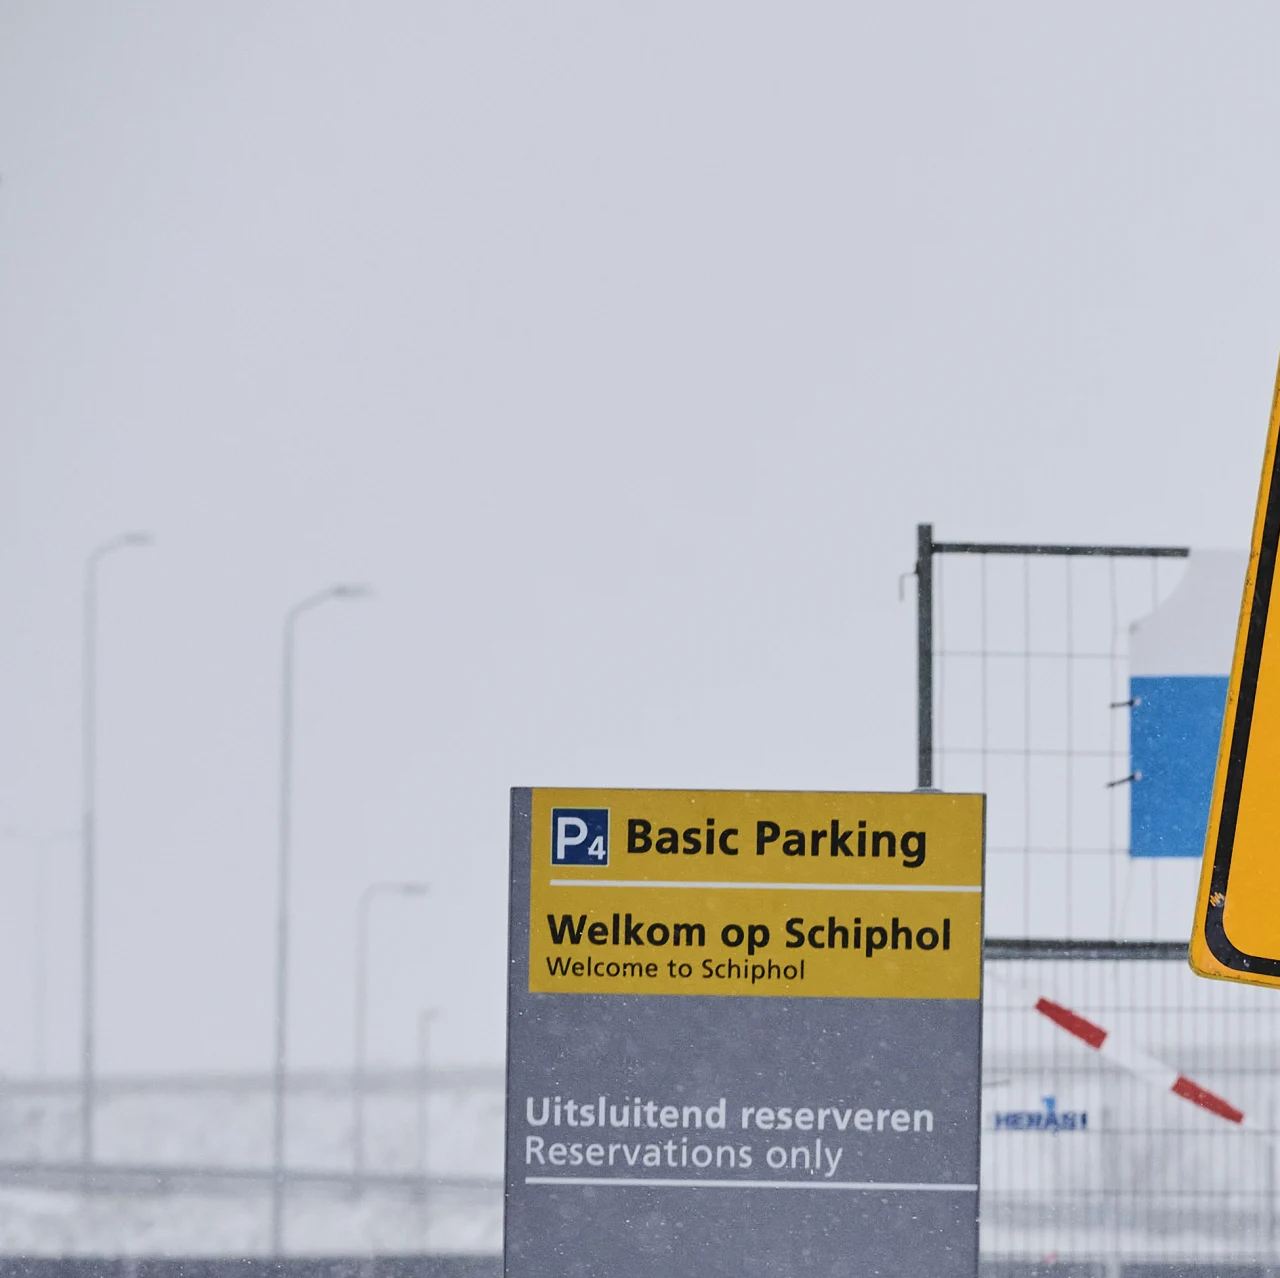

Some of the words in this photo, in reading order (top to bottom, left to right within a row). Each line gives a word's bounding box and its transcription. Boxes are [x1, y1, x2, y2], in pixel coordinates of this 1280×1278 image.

[627, 818, 739, 855] Basic
[756, 820, 927, 868] Parking
[547, 913, 706, 946] Welkom
[720, 924, 770, 955] op
[785, 917, 951, 957] Schiphol
[547, 957, 658, 978] Welcome
[667, 960, 693, 978] to
[702, 959, 805, 985] Schiphol
[526, 1096, 727, 1129] Uitsluitend
[741, 1105, 934, 1132] reserveren
[525, 1135, 753, 1168] Reservations
[766, 1138, 843, 1177] only
